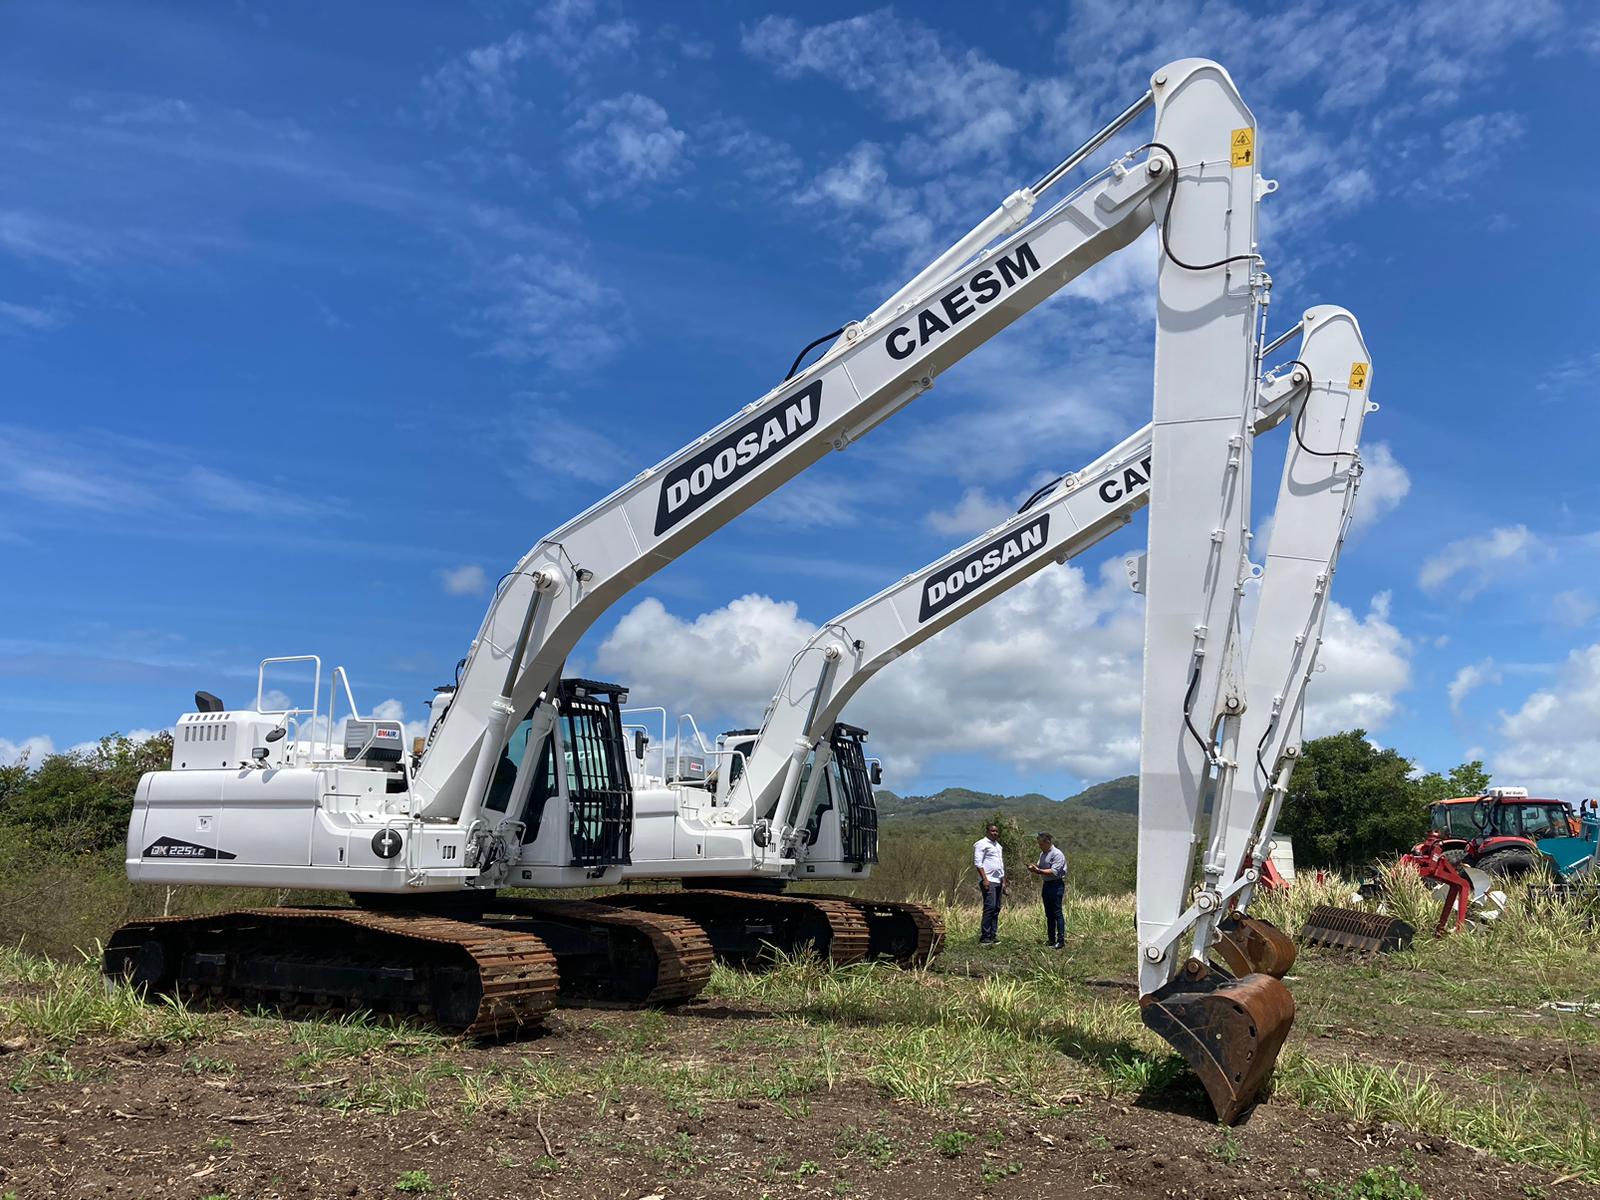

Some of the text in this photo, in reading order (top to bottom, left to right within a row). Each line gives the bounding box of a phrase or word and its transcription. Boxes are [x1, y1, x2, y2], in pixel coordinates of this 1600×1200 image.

[885, 242, 1041, 360] CAESM
[666, 394, 813, 513] DOOSAN
[928, 524, 1043, 607] DOOSAN
